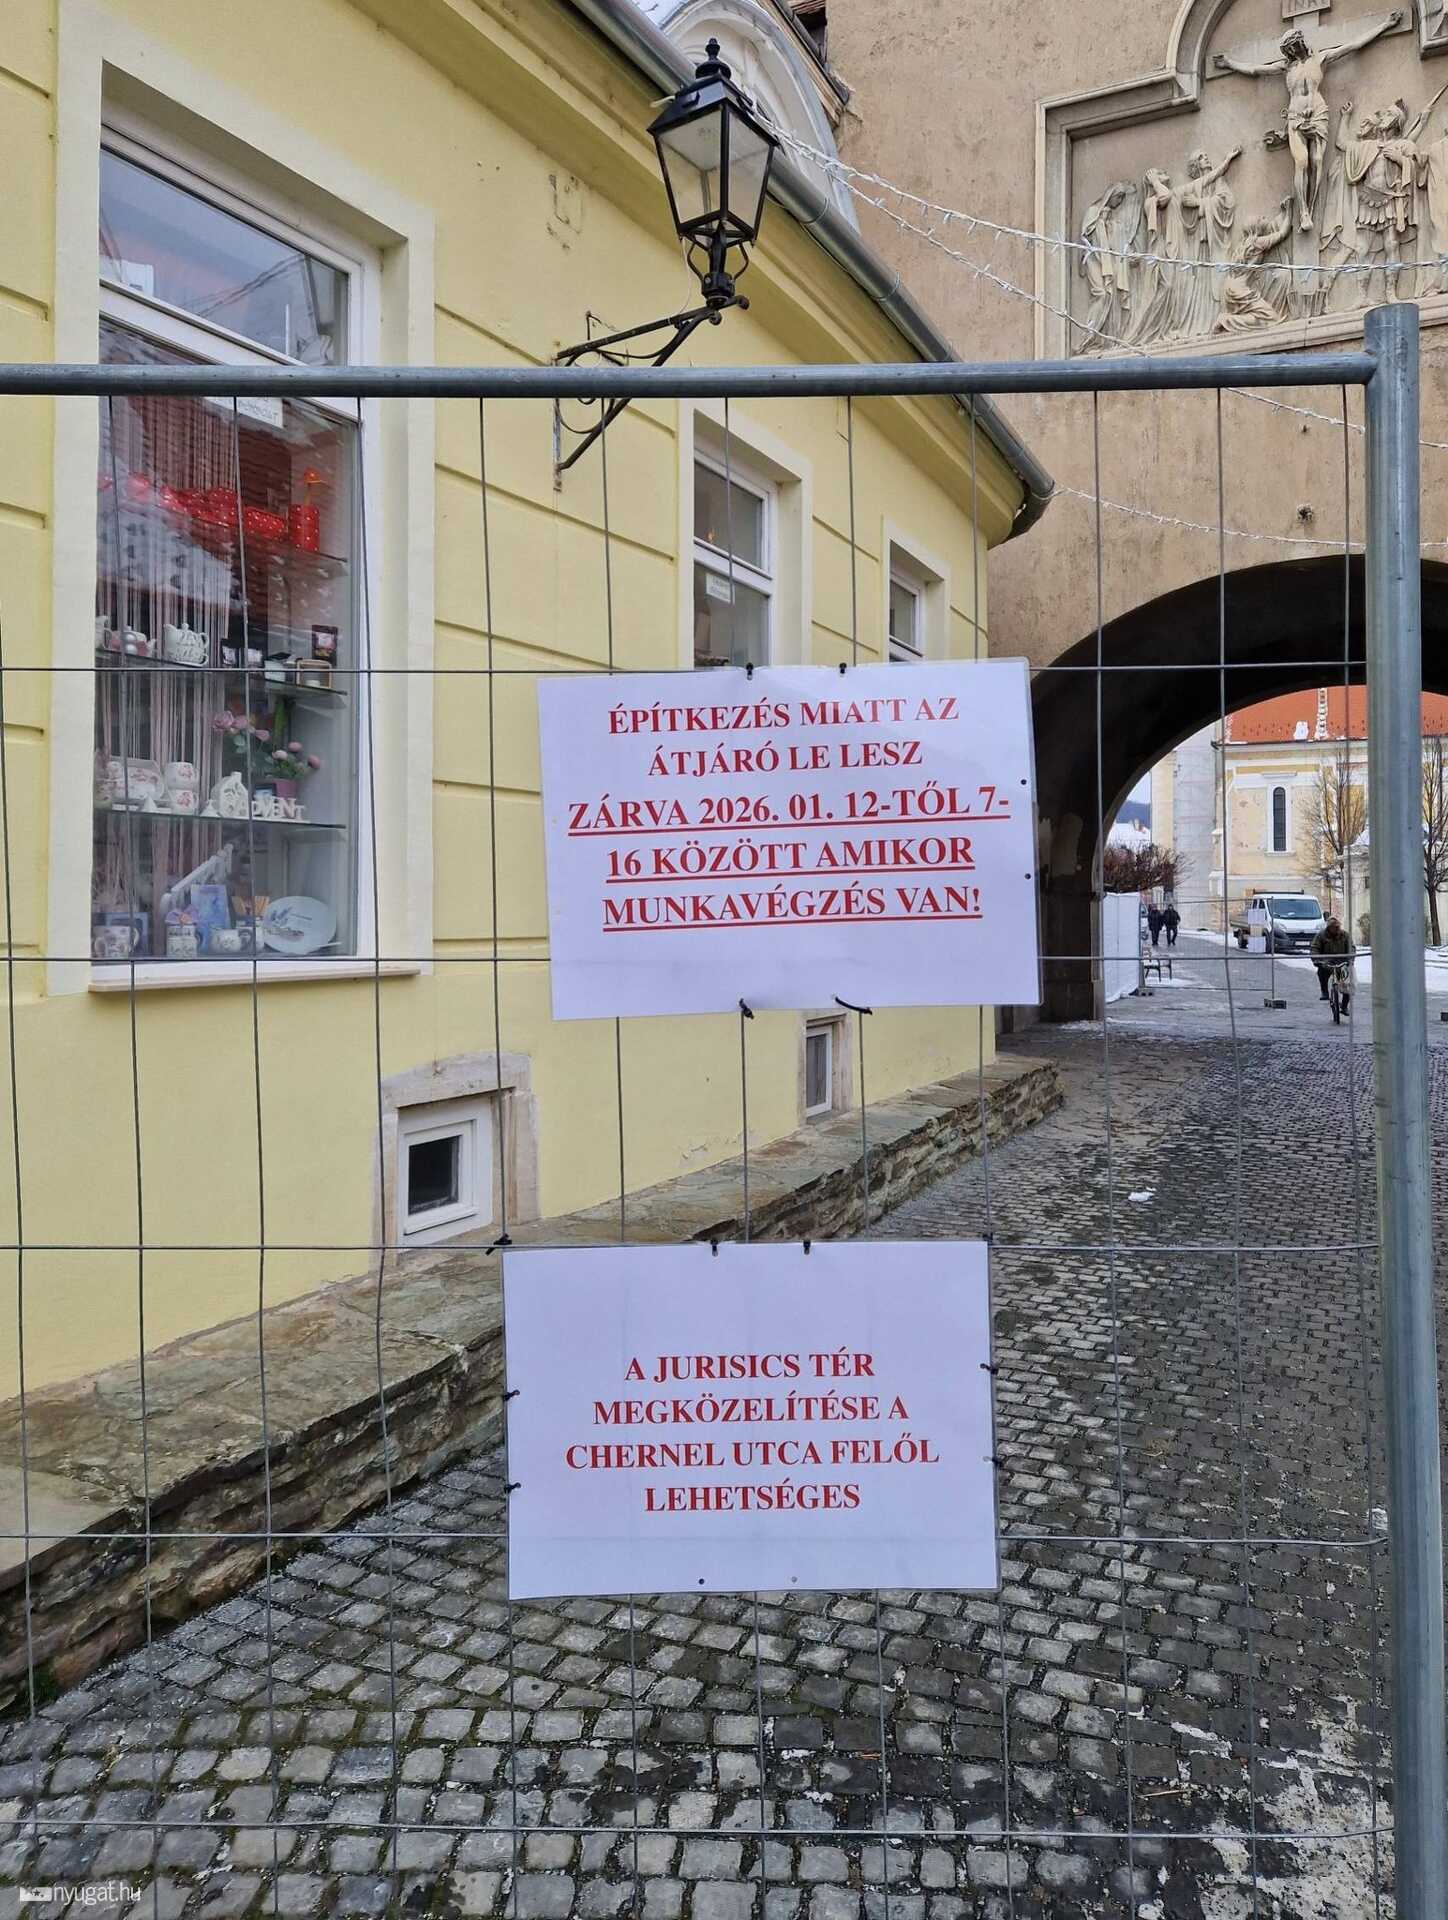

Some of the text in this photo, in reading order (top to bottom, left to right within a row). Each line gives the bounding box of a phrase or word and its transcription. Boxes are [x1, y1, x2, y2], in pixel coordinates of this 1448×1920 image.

[608, 697, 960, 735] ÉPÍTKEZÉS MIATT AZ
[648, 740, 923, 777] ÁTJÁRÓ LE LESZ
[568, 781, 1010, 830] ZÁRVA 2026. 01. 12-TŐL 7-
[607, 836, 974, 878] 16 KÖZÖTT AMIKOR
[603, 881, 981, 925] MUNKAVÉGZÉS VAN!
[624, 1347, 875, 1384] A JURISICS TÉR
[593, 1389, 909, 1425] MEGKÖZELÍTÉSE A
[565, 1433, 940, 1469] CHERNEL UTCA FELŐL
[644, 1478, 861, 1512] LEHETSÉGES
